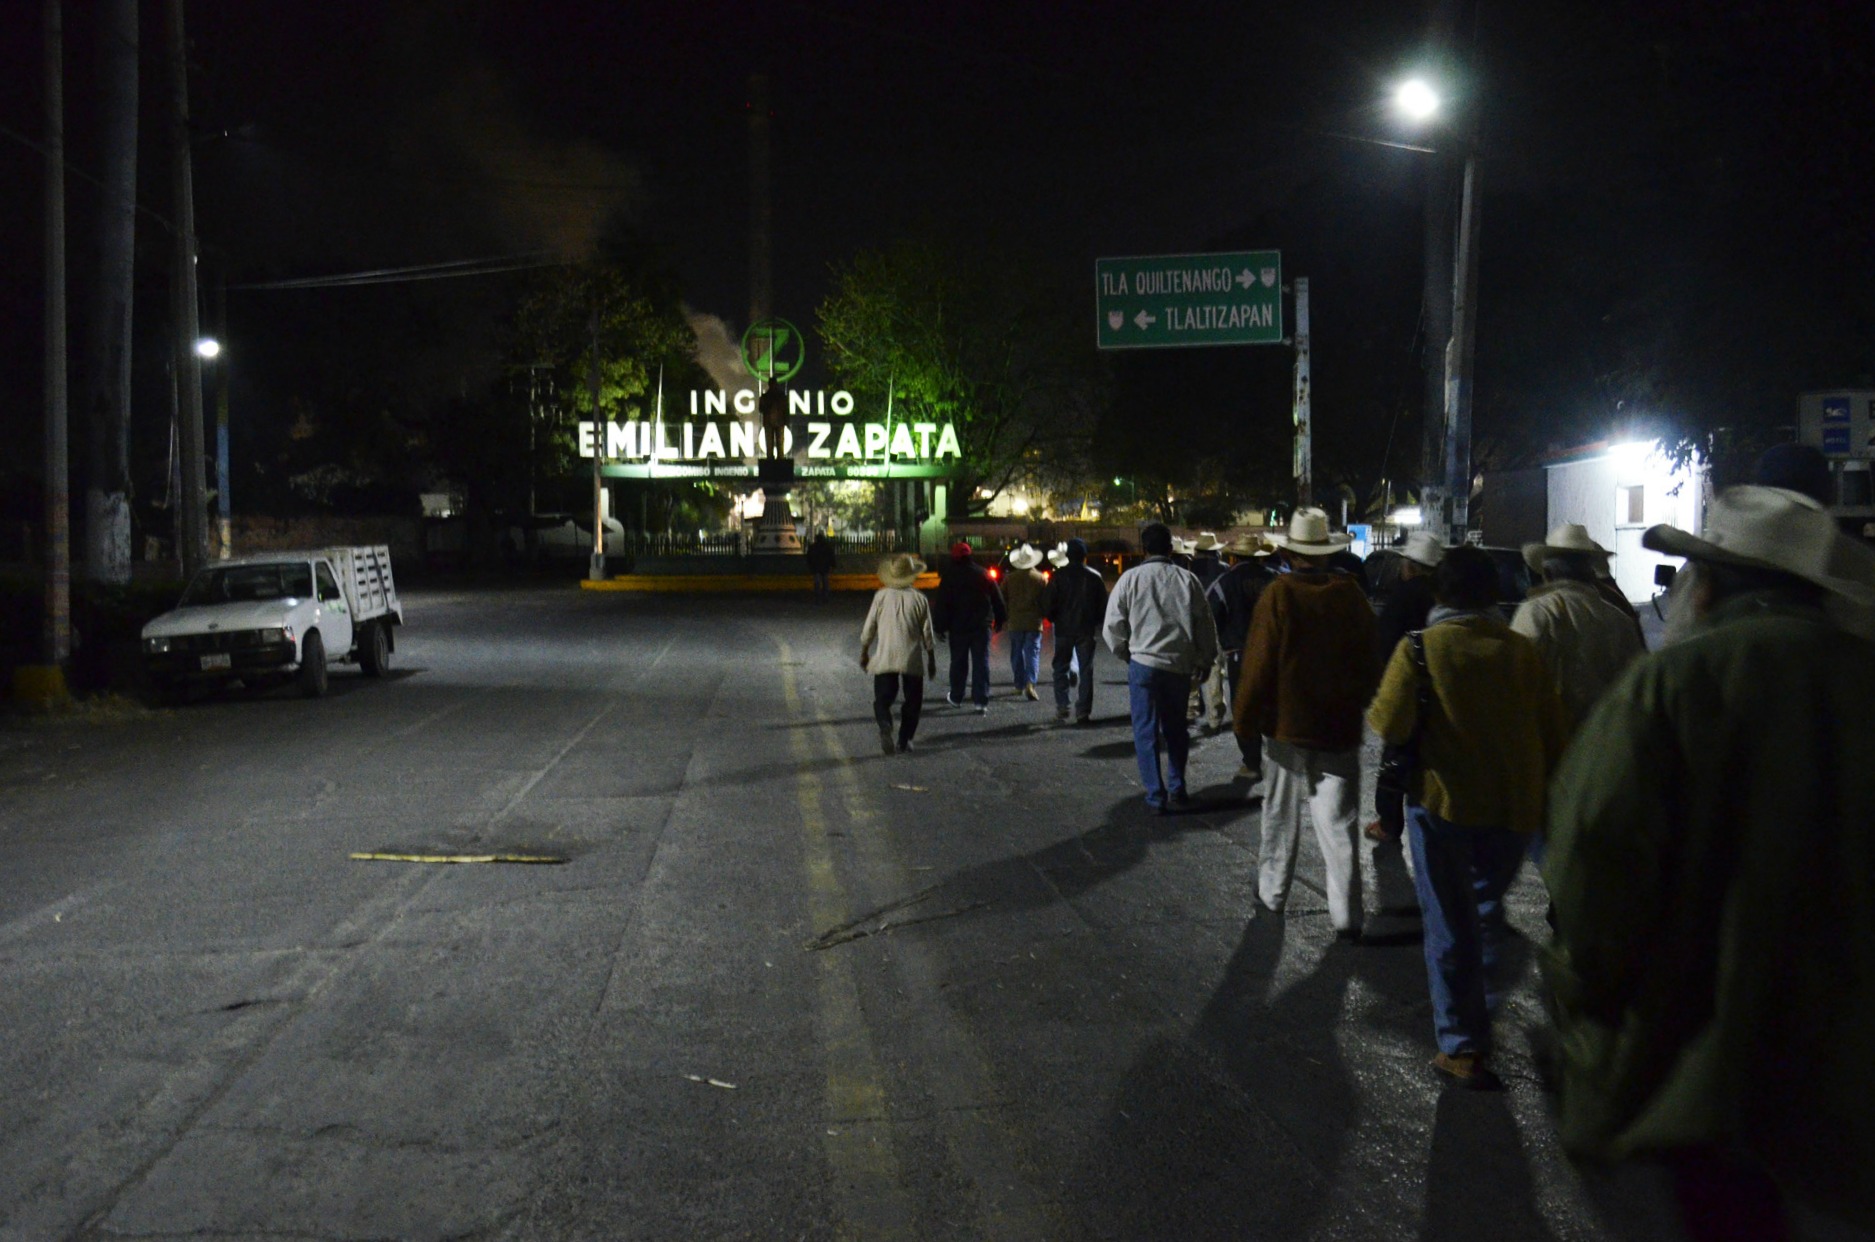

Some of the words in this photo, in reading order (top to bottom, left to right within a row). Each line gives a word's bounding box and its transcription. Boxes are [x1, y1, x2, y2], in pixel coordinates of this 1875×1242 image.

[1101, 272, 1128, 296] TLA
[1136, 268, 1231, 295] QUILTENANGO
[1165, 303, 1273, 331] TLALTIZAPAN
[753, 328, 789, 371] Z
[690, 389, 854, 415] INGNIO
[807, 421, 962, 459] ZAPATA
[714, 466, 749, 476] INGENIO
[801, 465, 836, 476] ZAPATA
